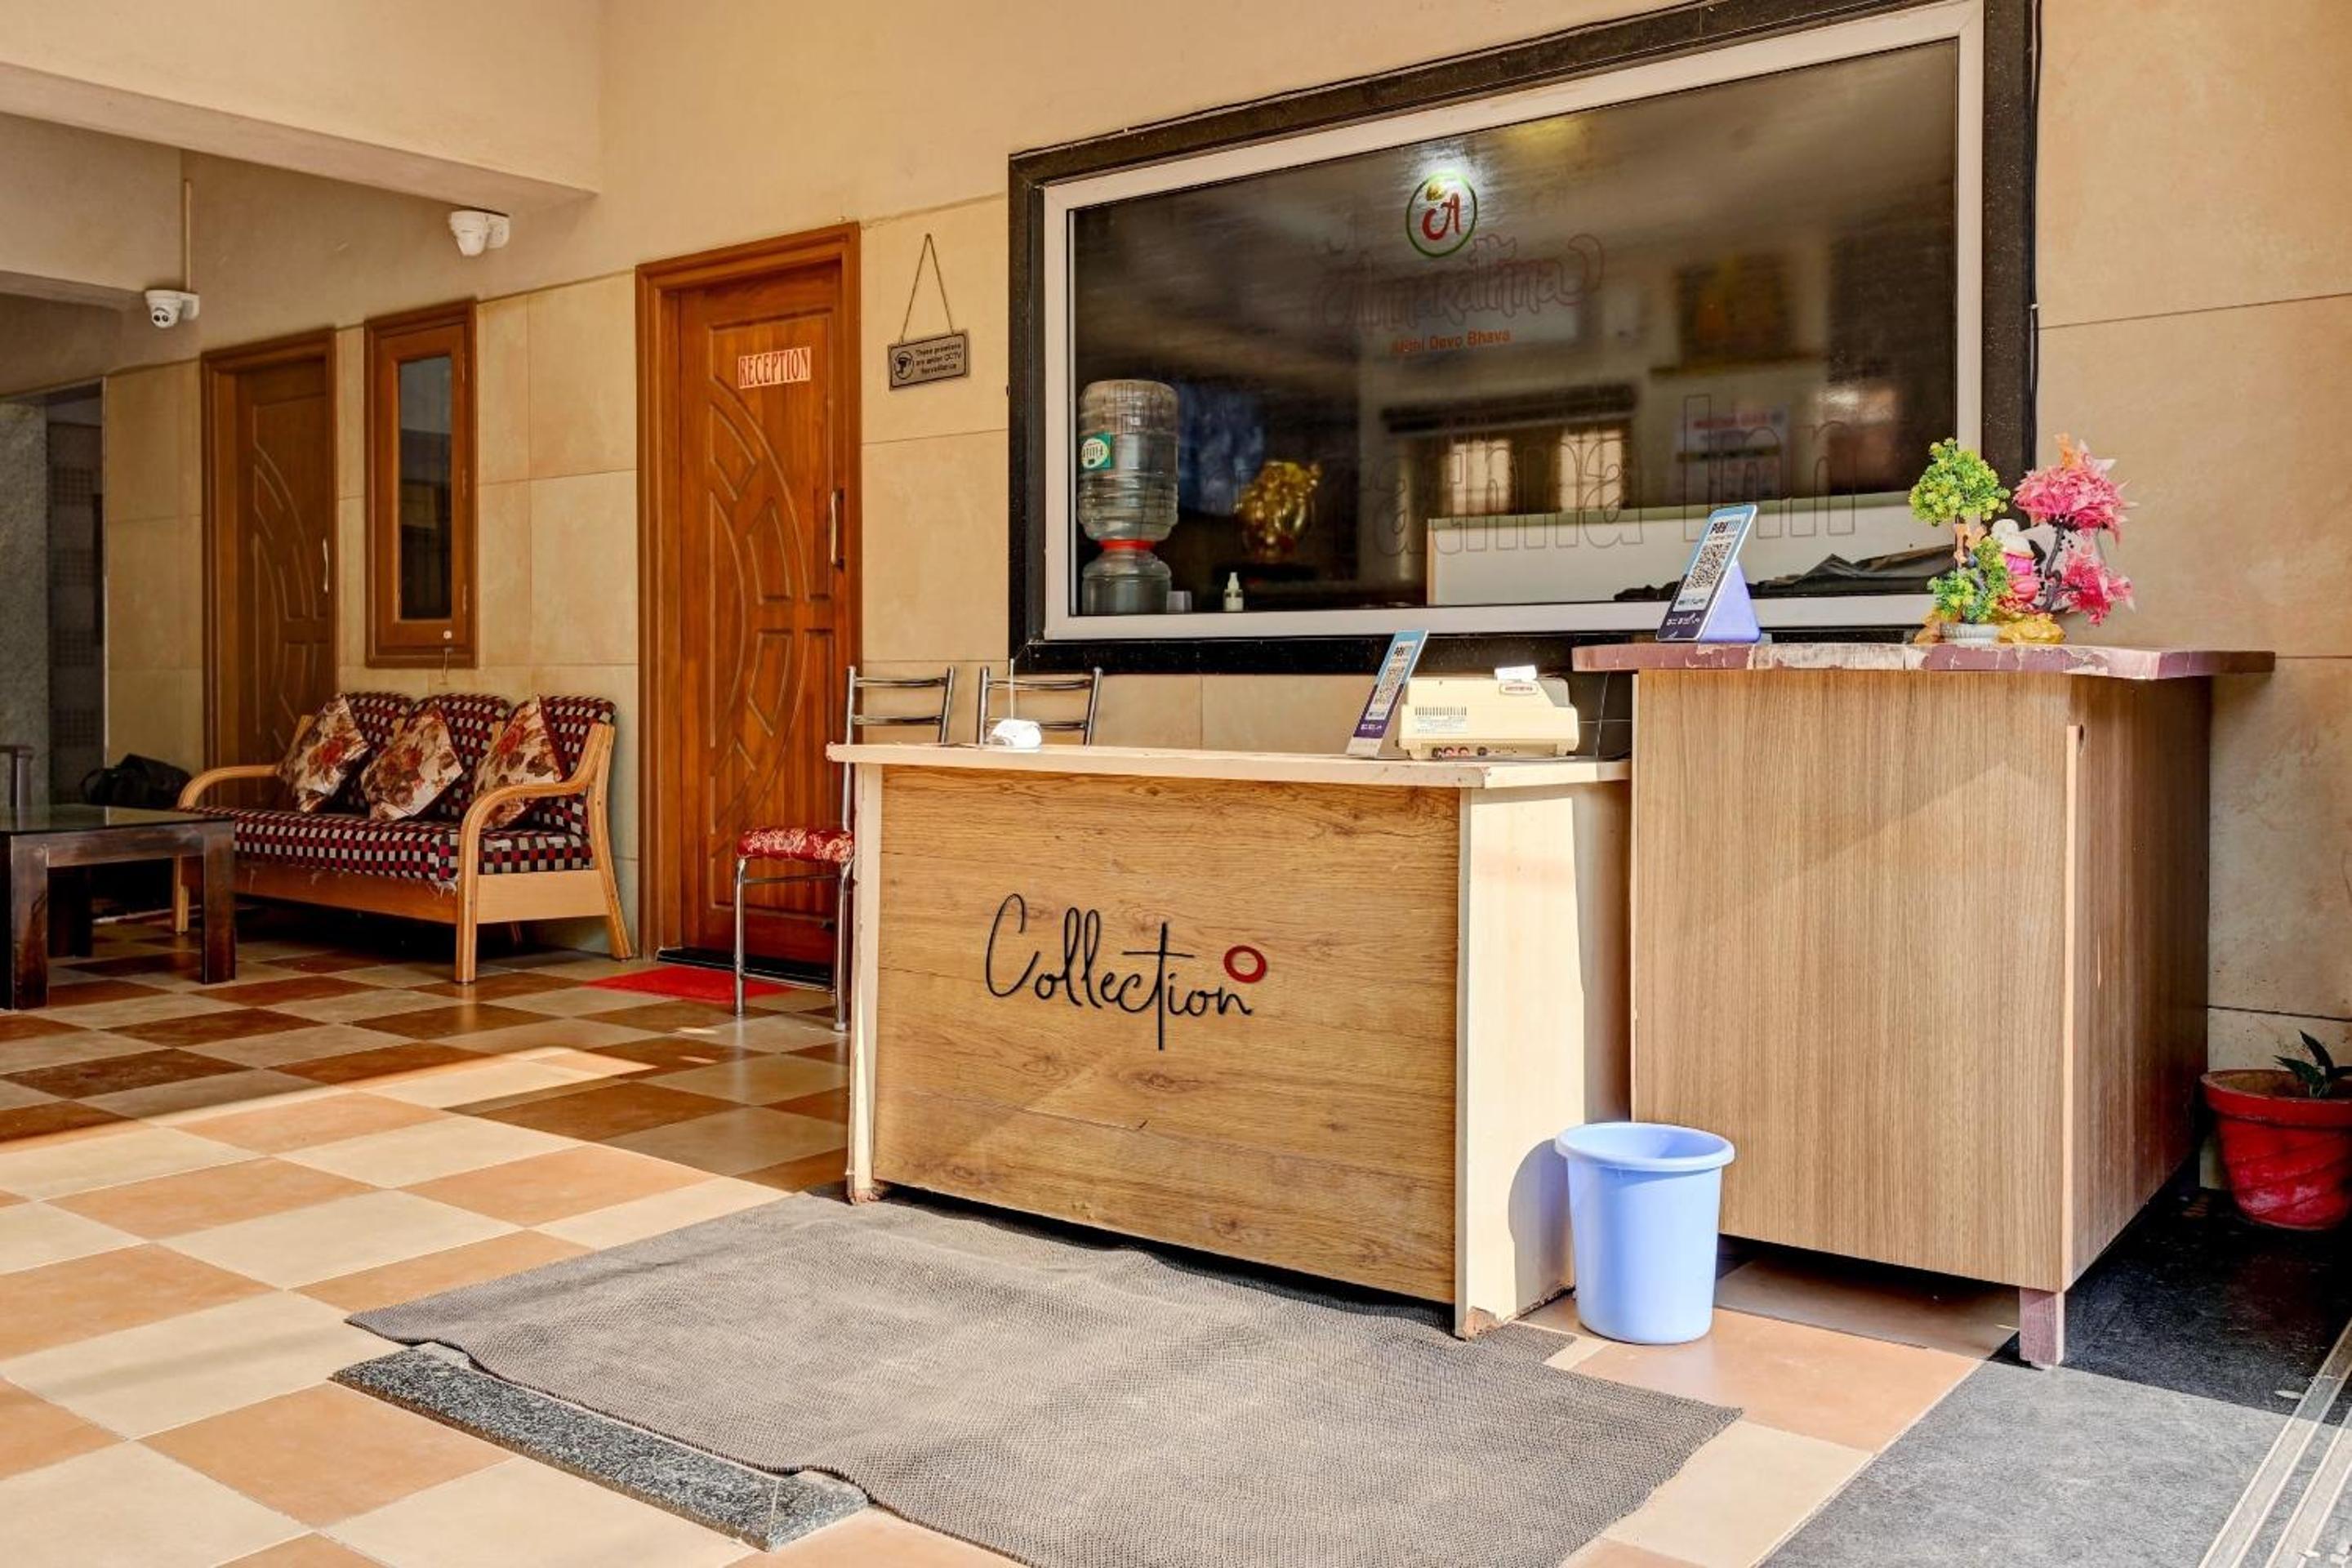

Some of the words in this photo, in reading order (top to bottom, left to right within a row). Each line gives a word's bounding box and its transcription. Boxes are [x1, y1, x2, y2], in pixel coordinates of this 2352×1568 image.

[739, 348, 809, 387] RECEPTION
[943, 352, 962, 362] CCTV
[986, 893, 1254, 1051] Collection
